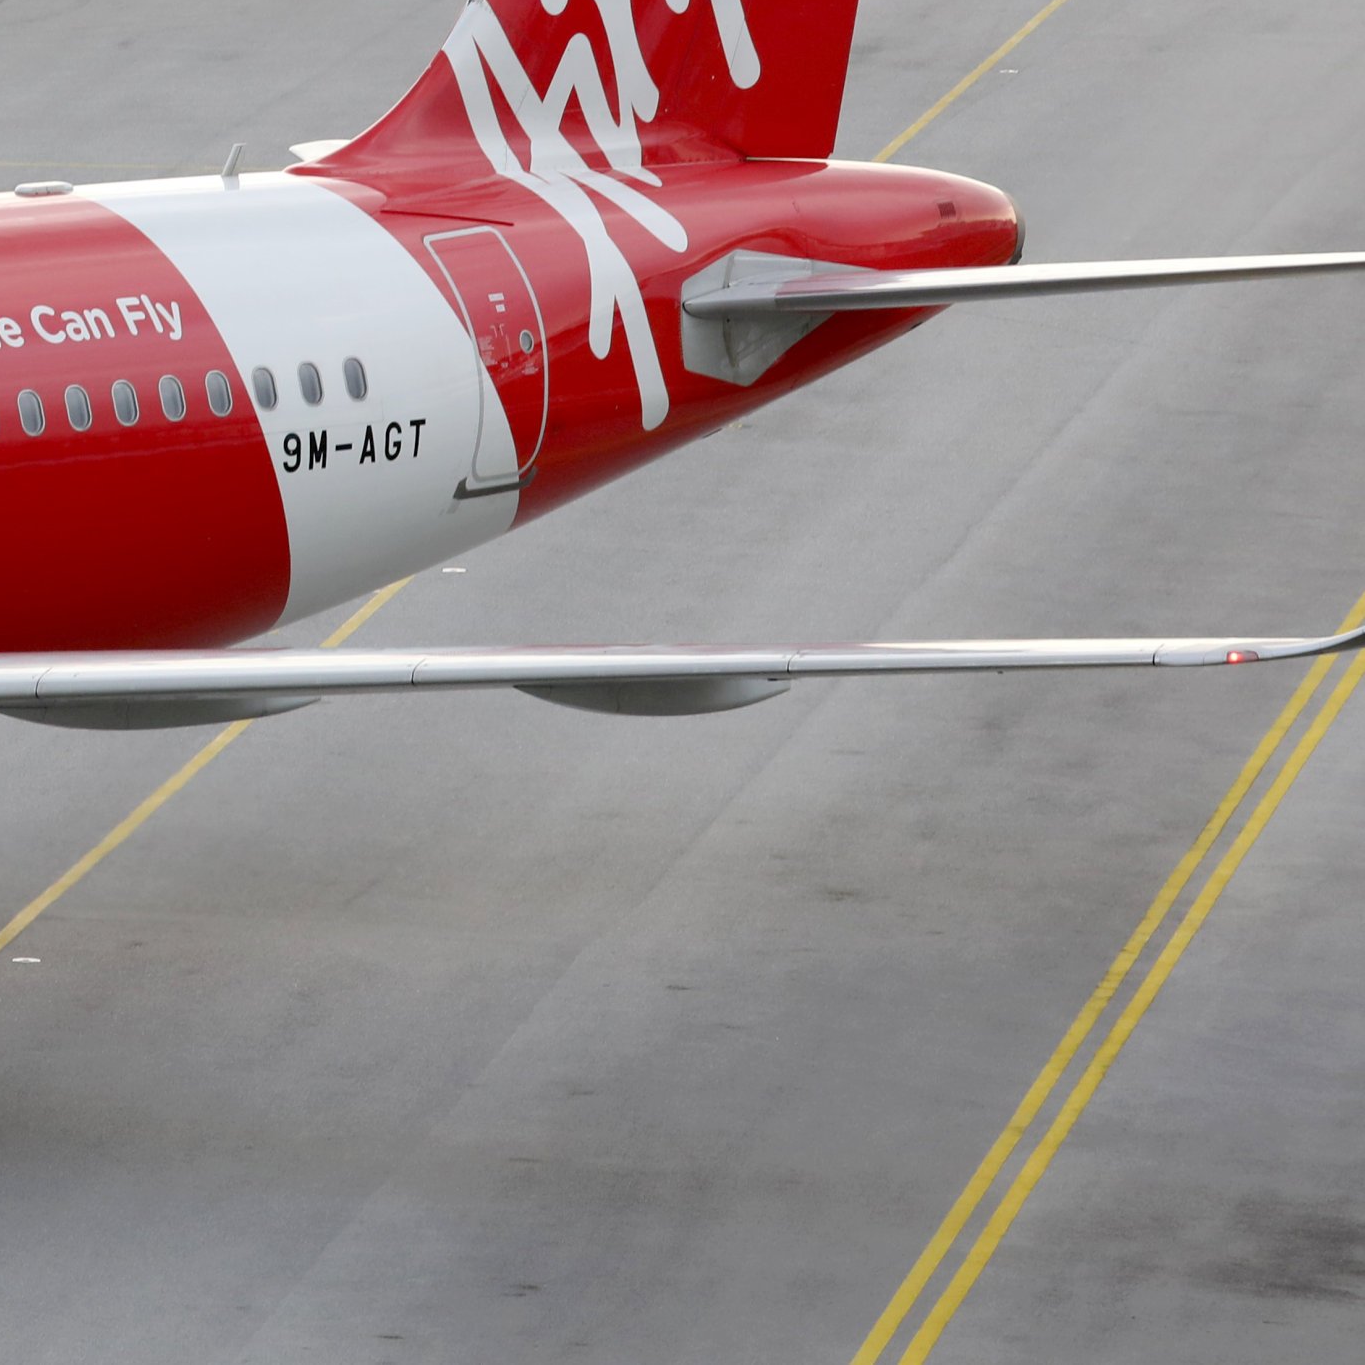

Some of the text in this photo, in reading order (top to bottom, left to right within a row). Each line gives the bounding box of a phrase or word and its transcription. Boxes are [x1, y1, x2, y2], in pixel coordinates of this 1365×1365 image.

[31, 304, 116, 344] Can
[115, 293, 183, 341] Fly
[282, 418, 427, 473] 9M-AGT
